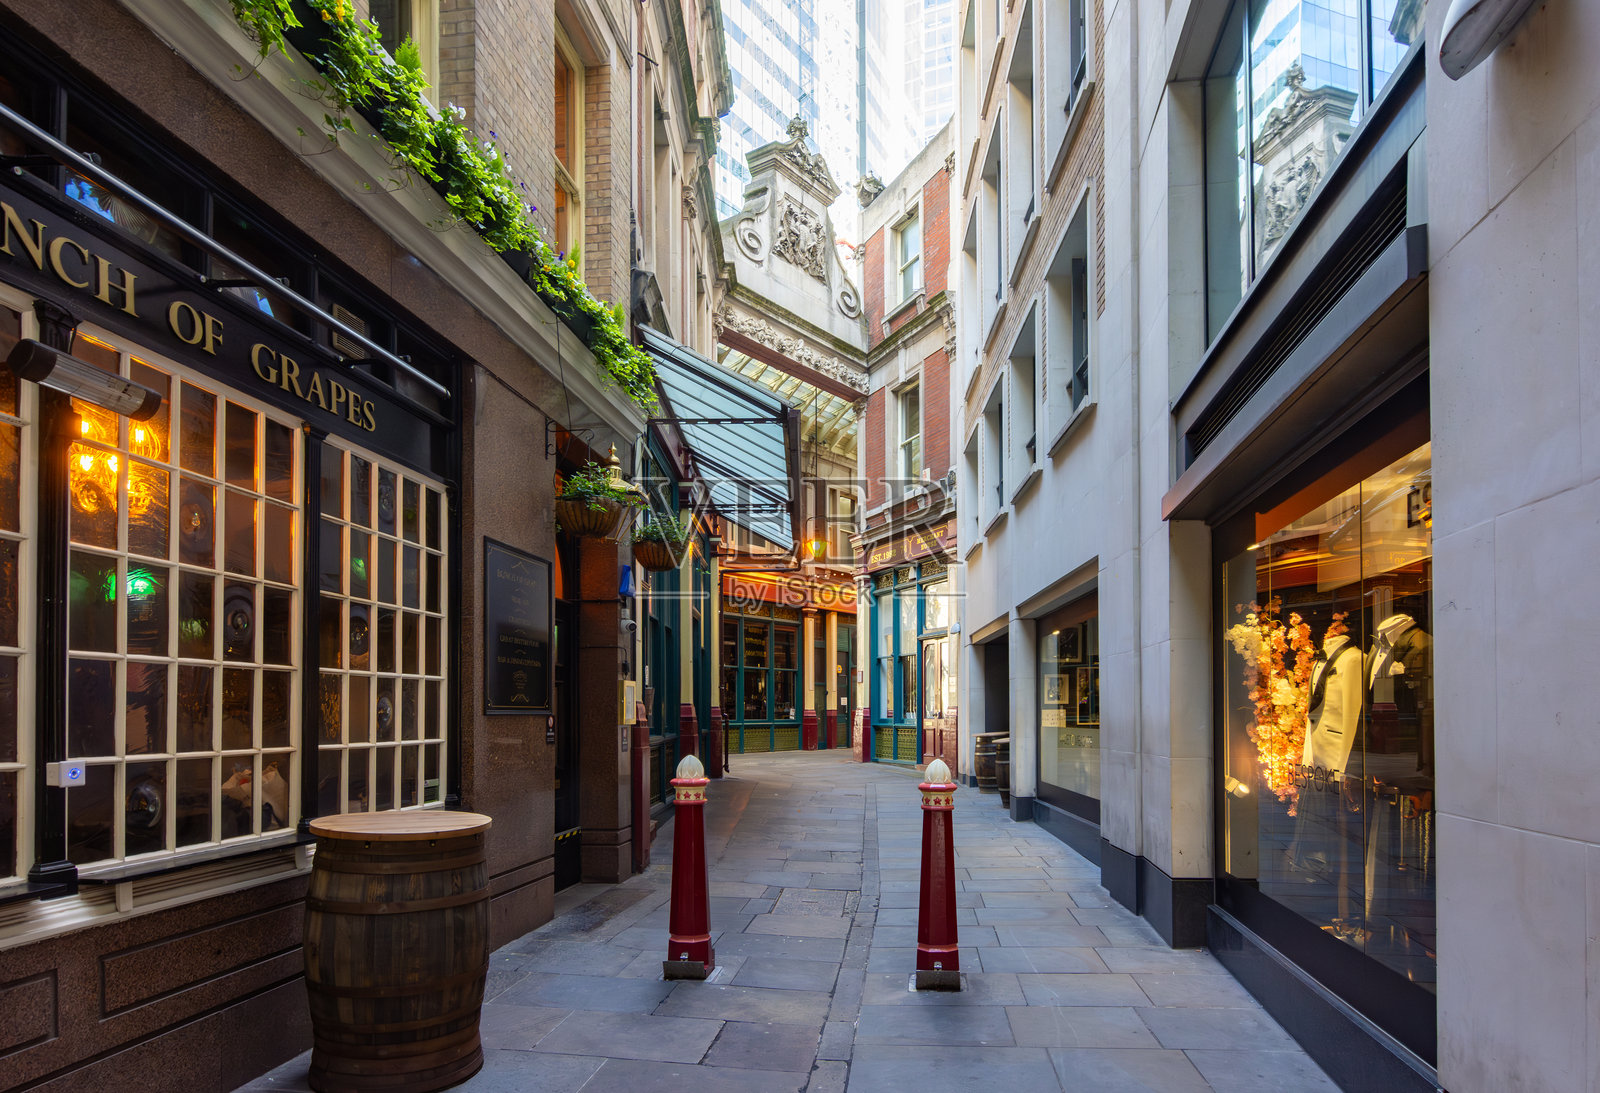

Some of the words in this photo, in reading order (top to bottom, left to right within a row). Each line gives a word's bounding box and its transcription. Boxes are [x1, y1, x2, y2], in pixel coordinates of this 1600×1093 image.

[168, 301, 224, 356] OF
[251, 342, 376, 432] GRAPES
[916, 529, 943, 544] MERCHANT
[1288, 762, 1339, 795] BESPOKE
